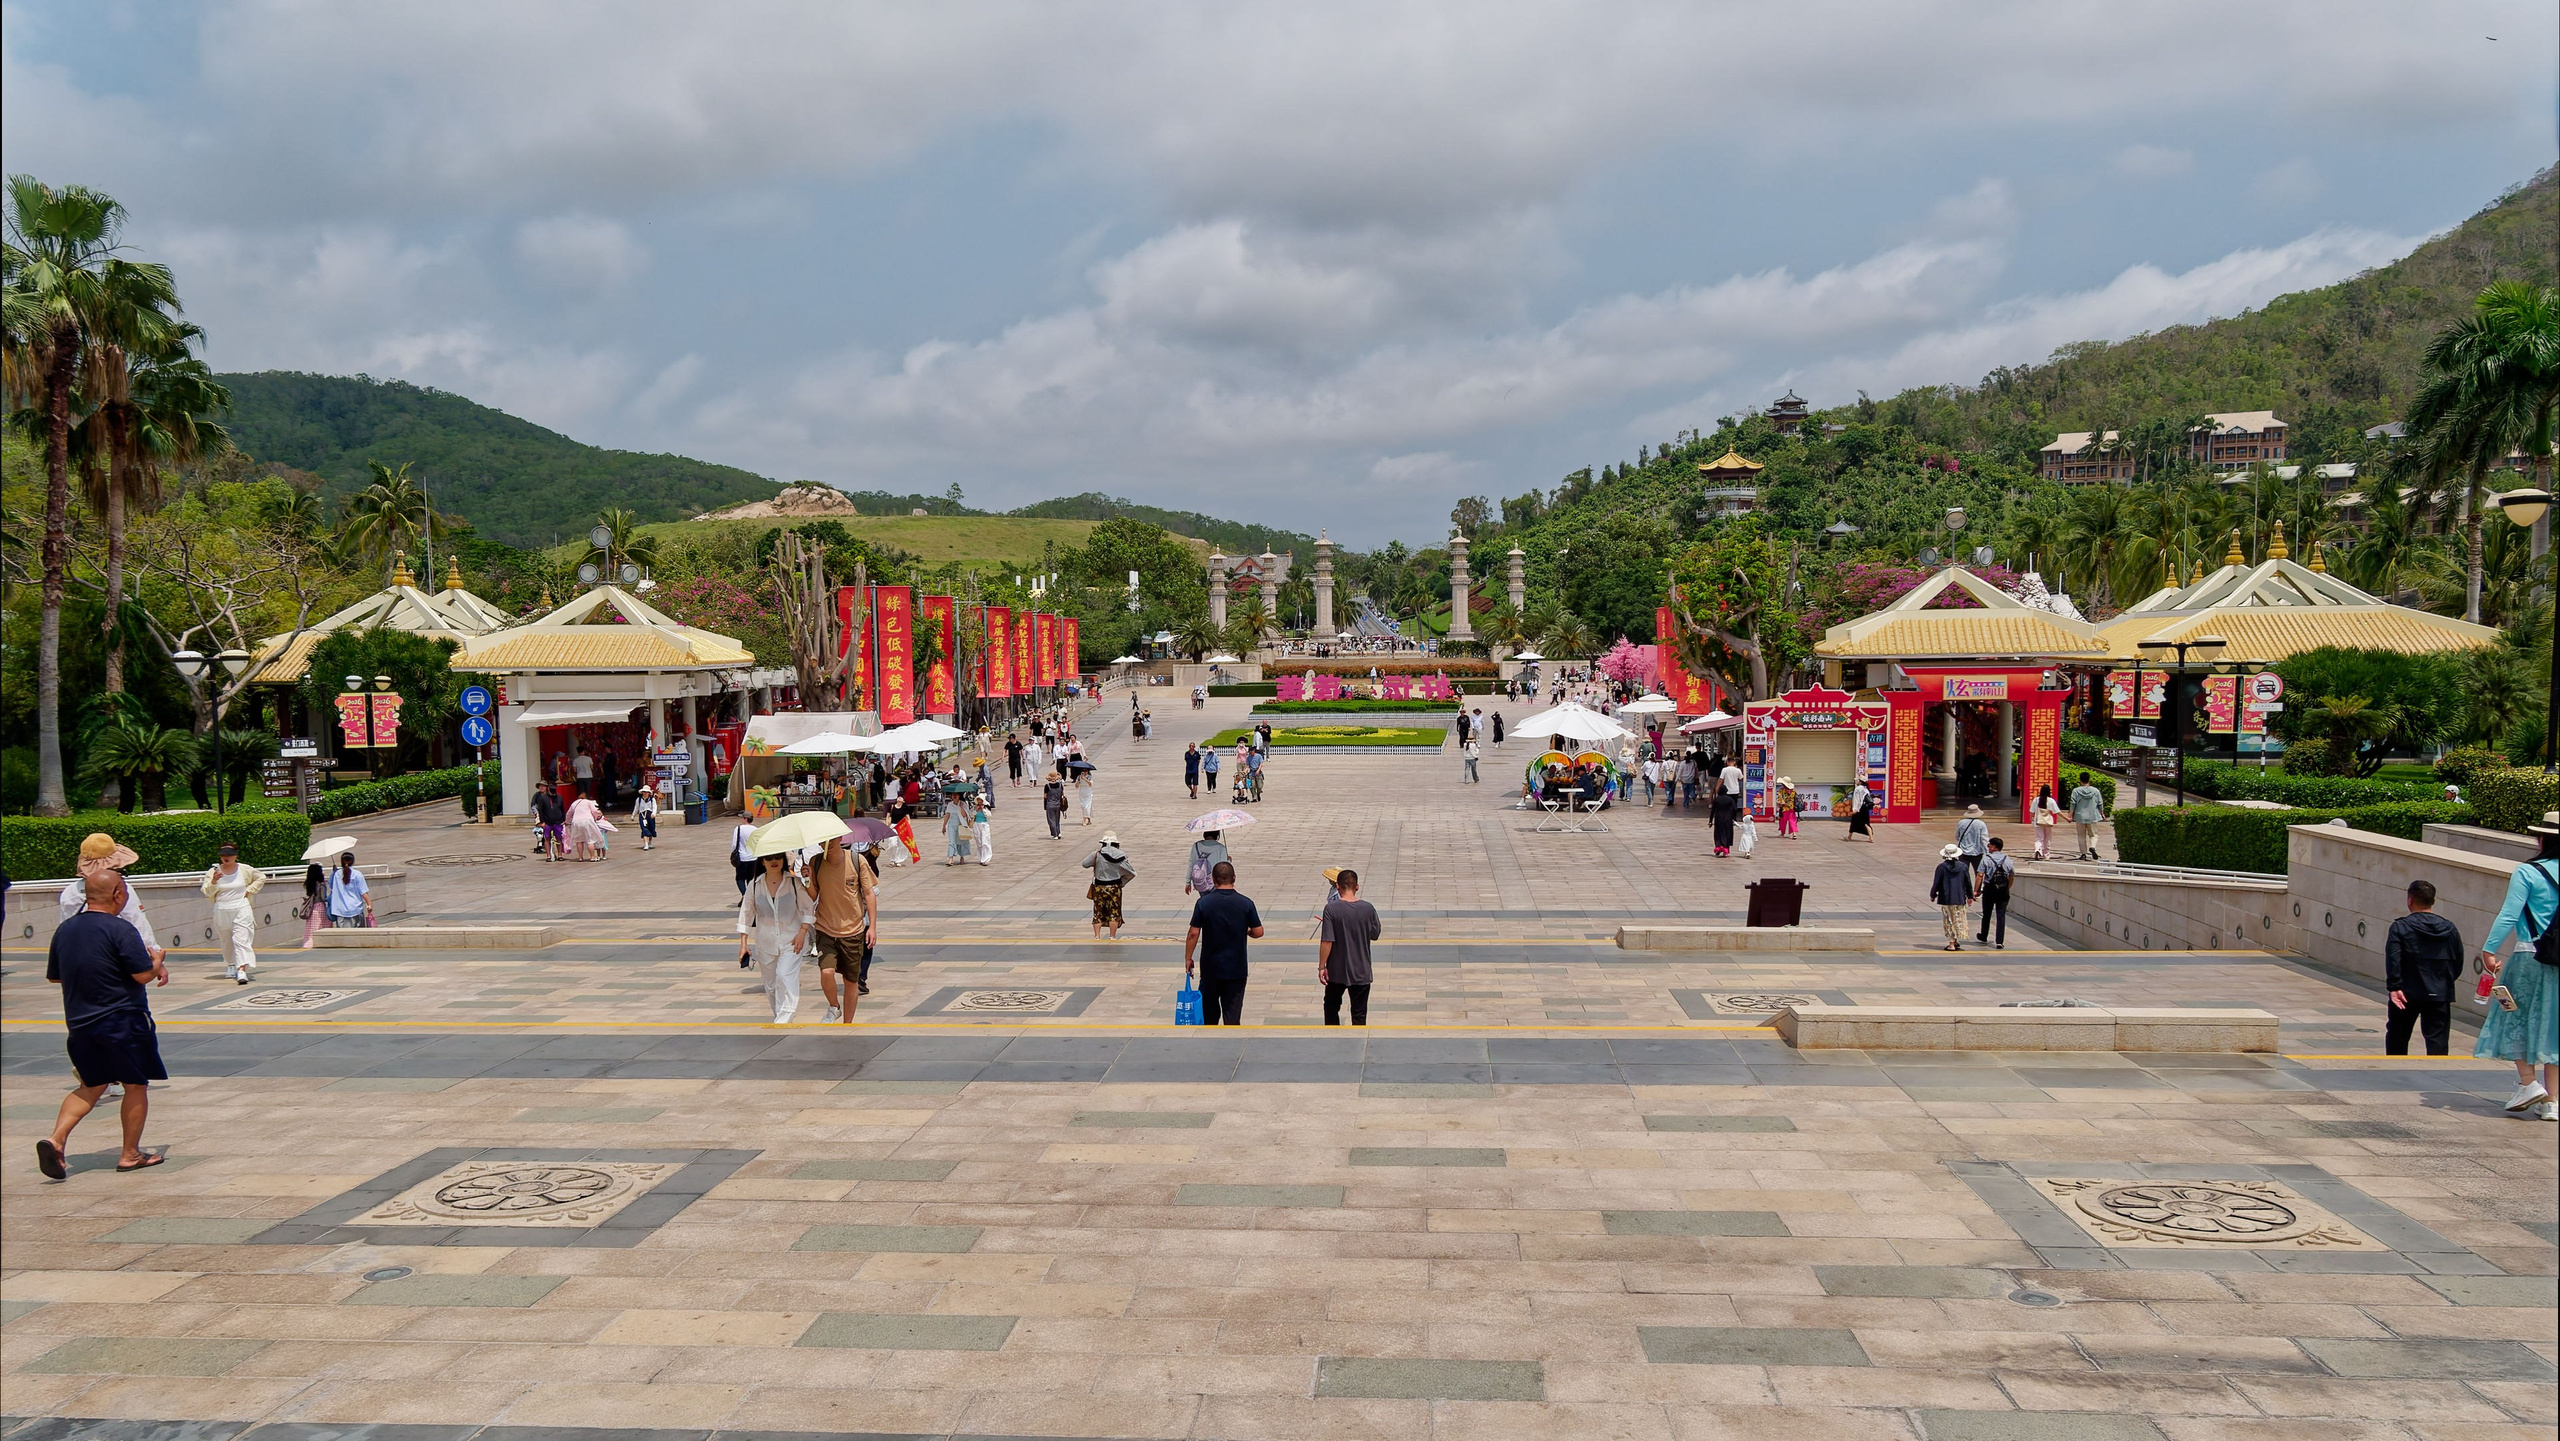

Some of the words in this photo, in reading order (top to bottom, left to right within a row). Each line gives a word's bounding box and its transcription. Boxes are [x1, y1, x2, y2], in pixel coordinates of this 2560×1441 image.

[886, 595, 905, 711] 綠色低碳發展
[931, 607, 947, 706] 燈吉歲歲歡
[993, 615, 1005, 691] 春風得意馬蹄疾
[2117, 673, 2133, 681] 2026
[2143, 673, 2159, 681] 2026
[1685, 673, 1702, 705] 新春
[2215, 680, 2232, 688] 2026
[375, 697, 391, 705] 2026
[1802, 714, 1833, 723] 炫彩南山
[1745, 750, 1760, 764] 福
